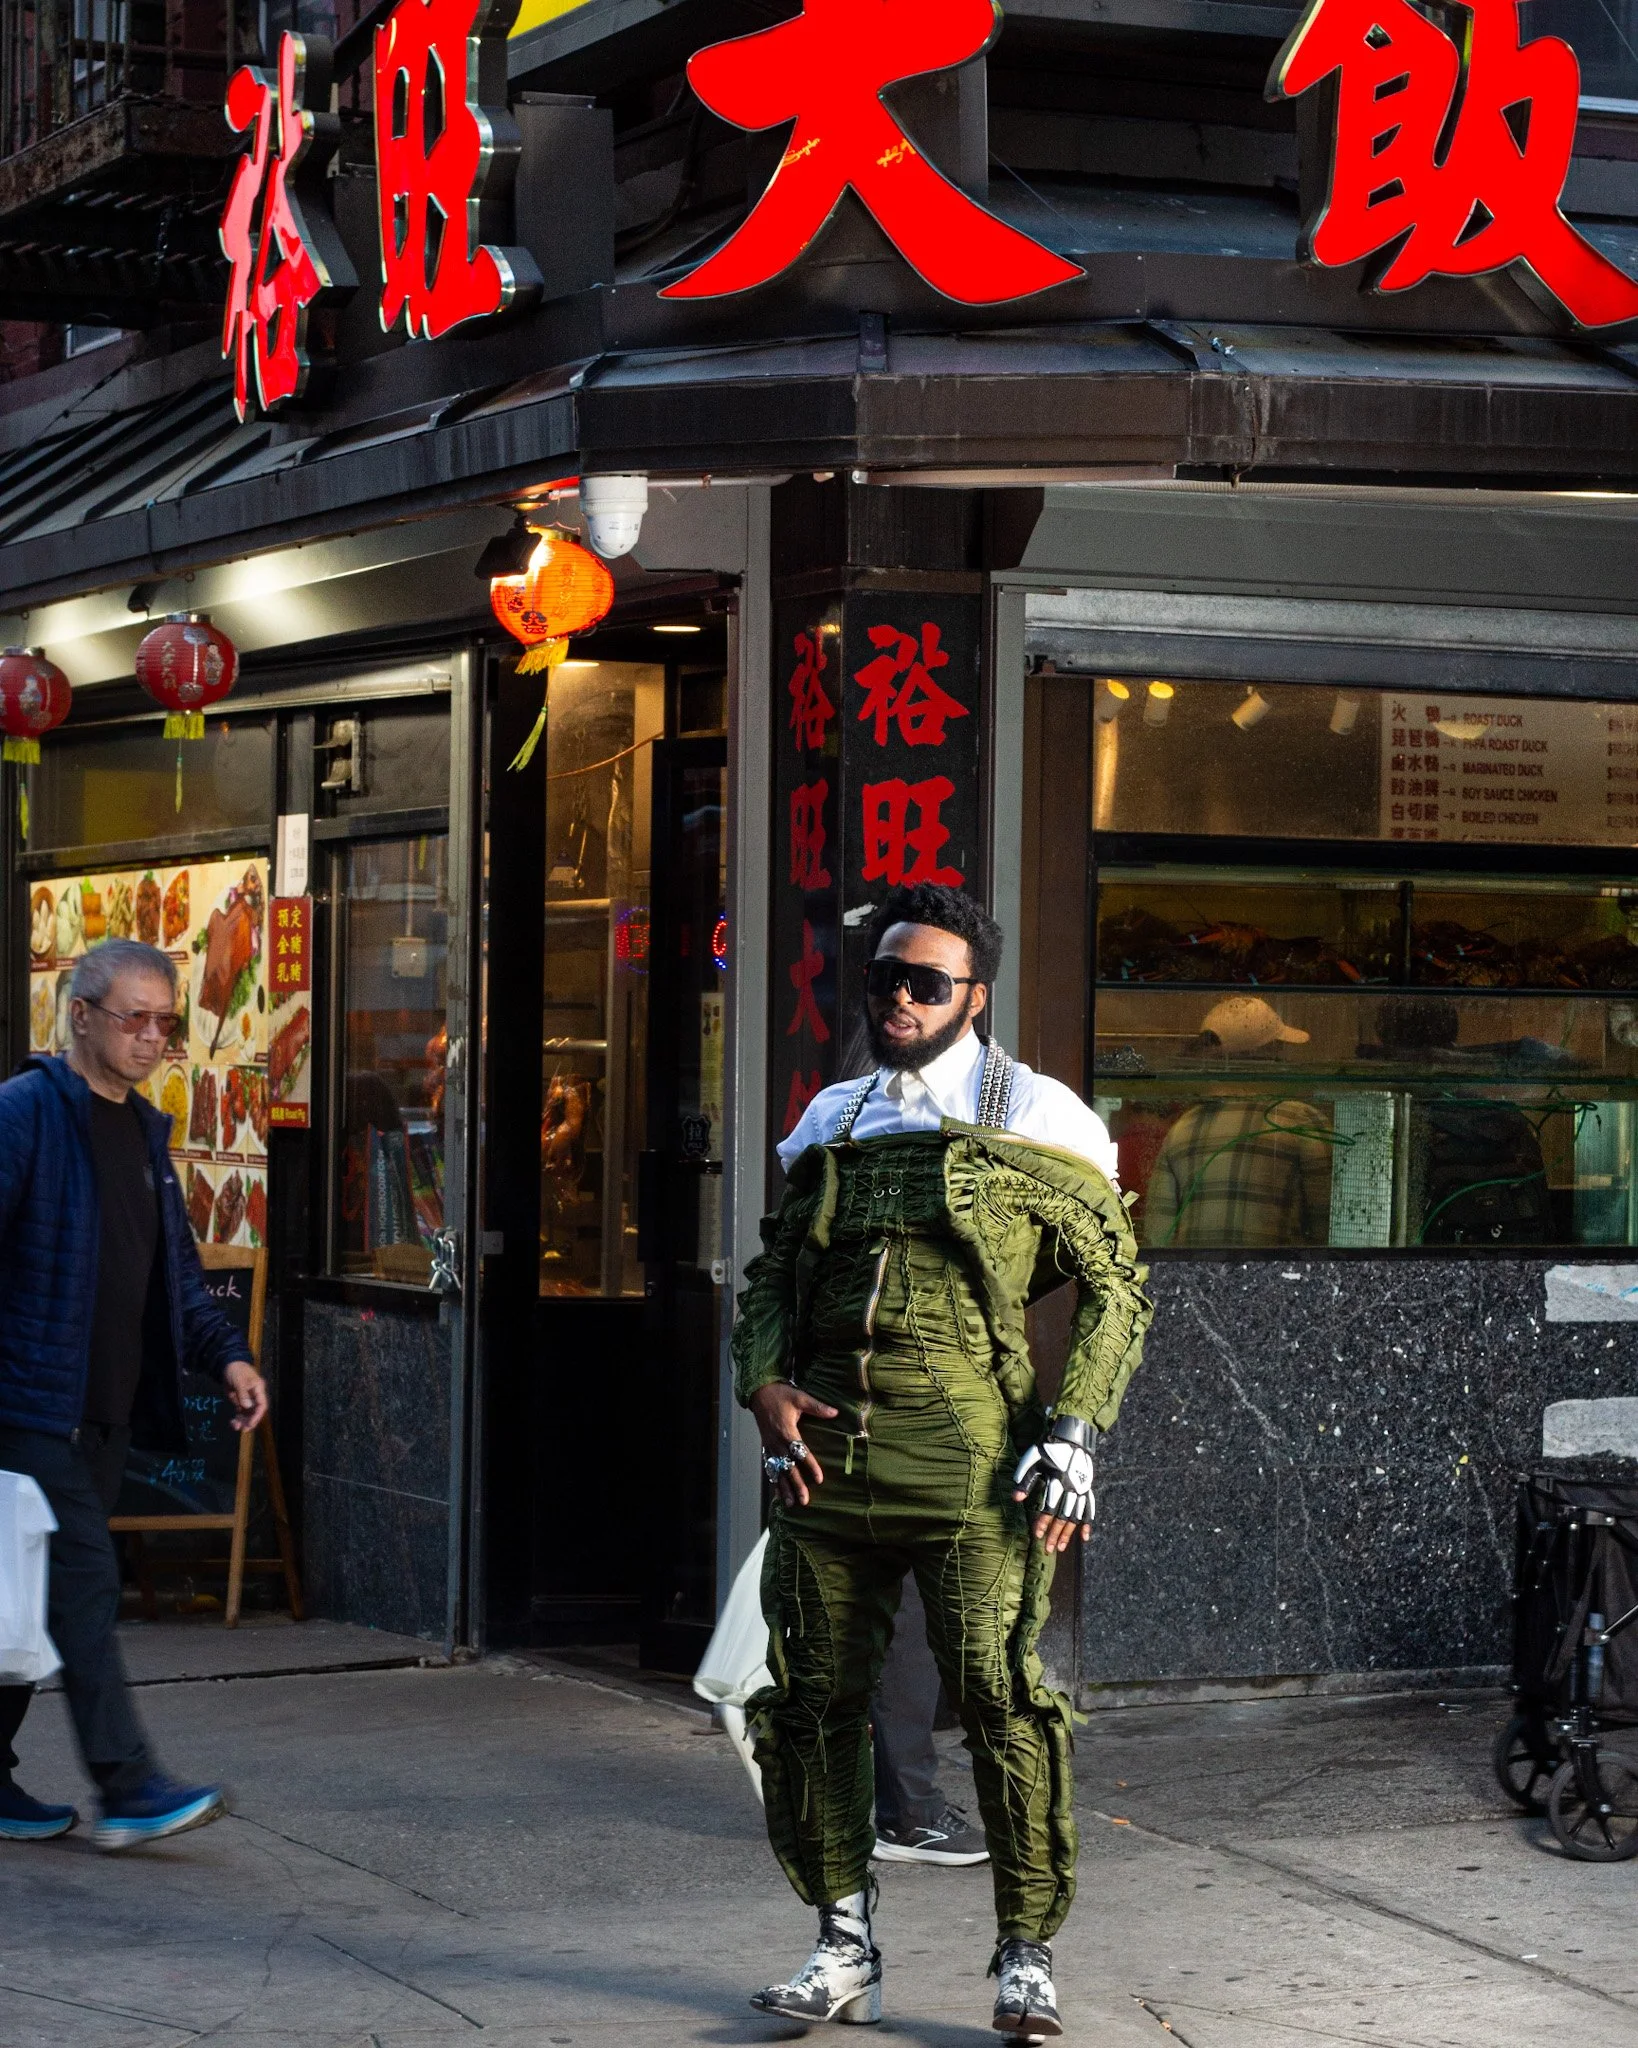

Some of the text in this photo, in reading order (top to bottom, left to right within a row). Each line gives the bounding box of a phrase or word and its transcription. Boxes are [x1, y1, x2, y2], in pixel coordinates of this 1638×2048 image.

[1463, 712, 1523, 727] ROAST DUCK
[1488, 738, 1520, 751] ROAST
[1521, 739, 1548, 753] DUCK
[854, 620, 970, 888] 裕旺
[1462, 762, 1544, 777] MARINATED DUCK
[1462, 786, 1558, 802] SOY SAUCE CHICKEN
[1461, 810, 1539, 825] BOILED CHICKEN
